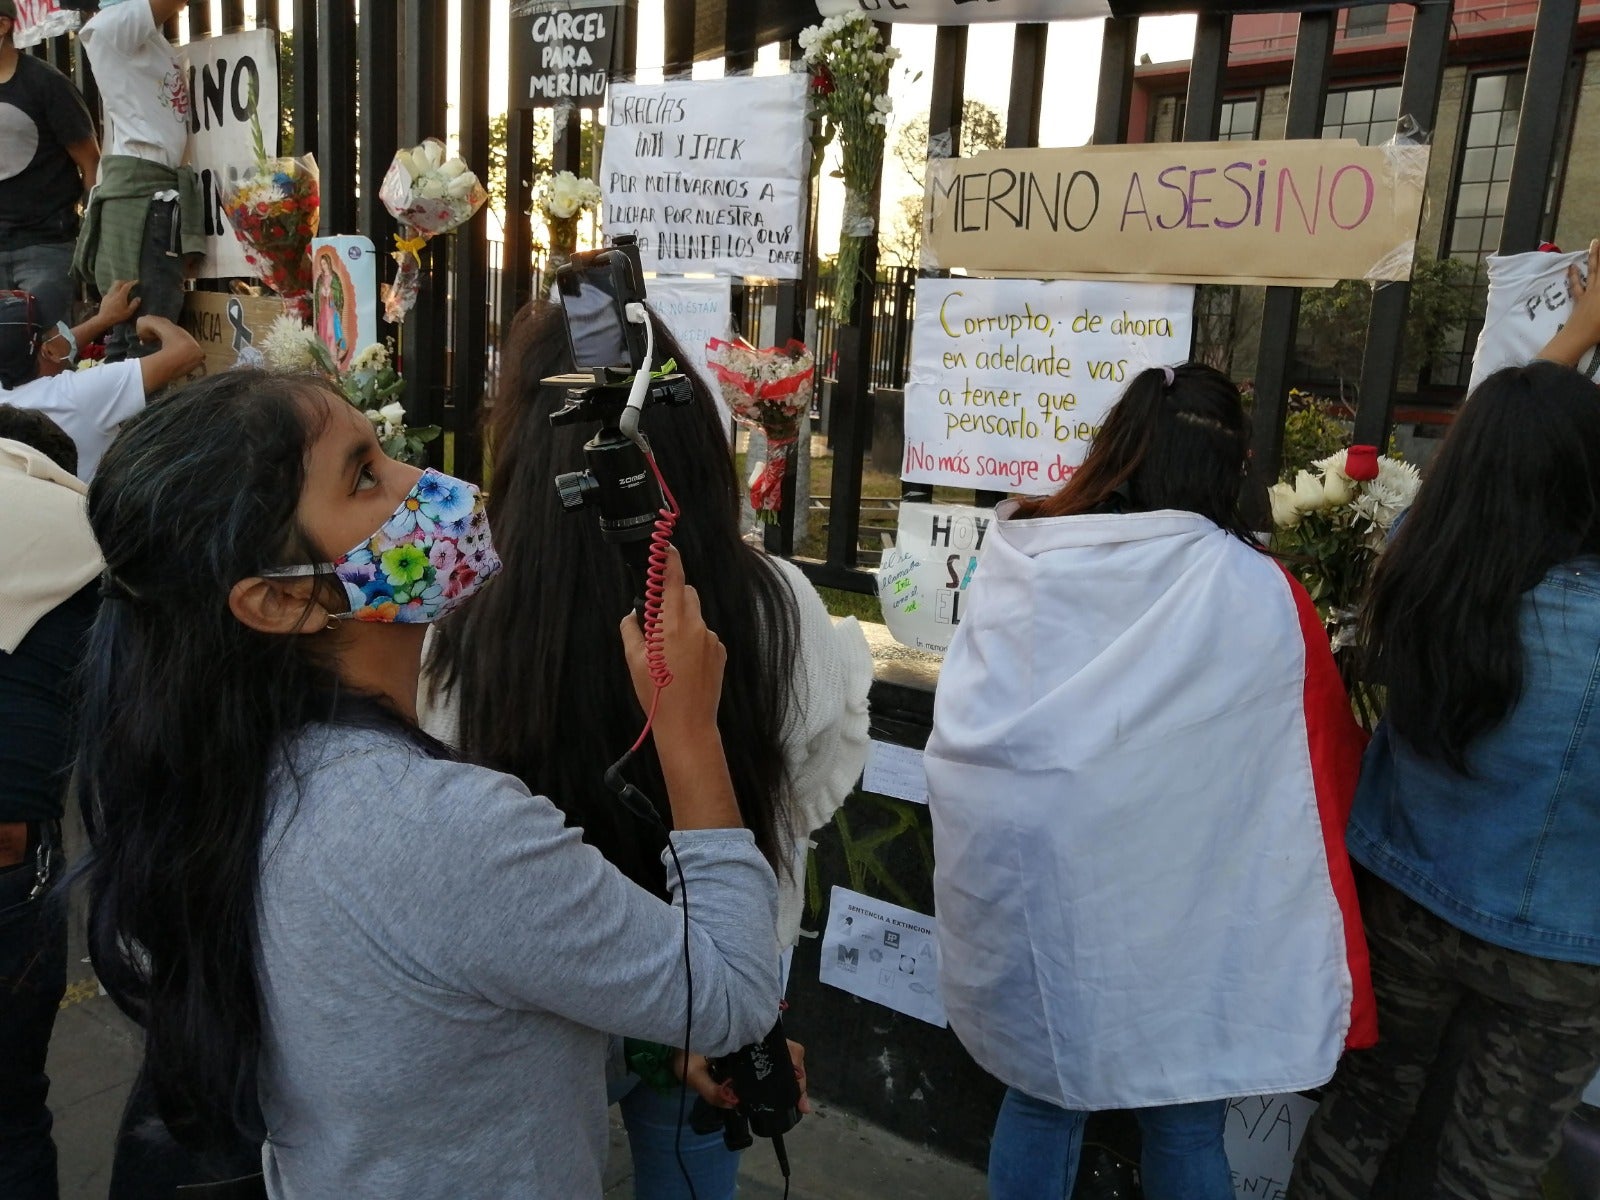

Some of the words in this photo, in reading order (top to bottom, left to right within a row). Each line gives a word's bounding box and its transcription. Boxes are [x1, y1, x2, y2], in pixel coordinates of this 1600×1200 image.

[531, 7, 606, 43] CÁRCEL
[541, 44, 593, 69] PARA
[187, 56, 260, 134] INO
[674, 134, 685, 158] Y
[689, 133, 745, 160] JACK
[609, 171, 637, 194] POR
[645, 170, 749, 199] MOTIVARNOS
[759, 182, 776, 203] A
[929, 168, 1100, 233] MERINO
[1119, 159, 1375, 235] ASESINO
[609, 204, 657, 225] LUCHAR
[664, 205, 693, 225] POR
[695, 204, 765, 227] NUESTRA
[658, 231, 721, 261] NUNCA
[727, 233, 755, 258] LOS
[1071, 308, 1103, 334] de
[1110, 310, 1173, 338] ahora
[942, 351, 967, 370] en
[975, 344, 1071, 378] adelante
[1086, 358, 1128, 384] vas
[938, 387, 953, 406] a
[960, 377, 1022, 408] tener
[1037, 391, 1077, 424] que
[944, 407, 1039, 440] pensarlo
[938, 448, 970, 476] más
[976, 454, 1039, 487] sangre
[931, 514, 990, 550] HOY
[935, 588, 961, 625] EL
[847, 904, 885, 922] SENTENCIA
[892, 919, 932, 936] EXTINCION
